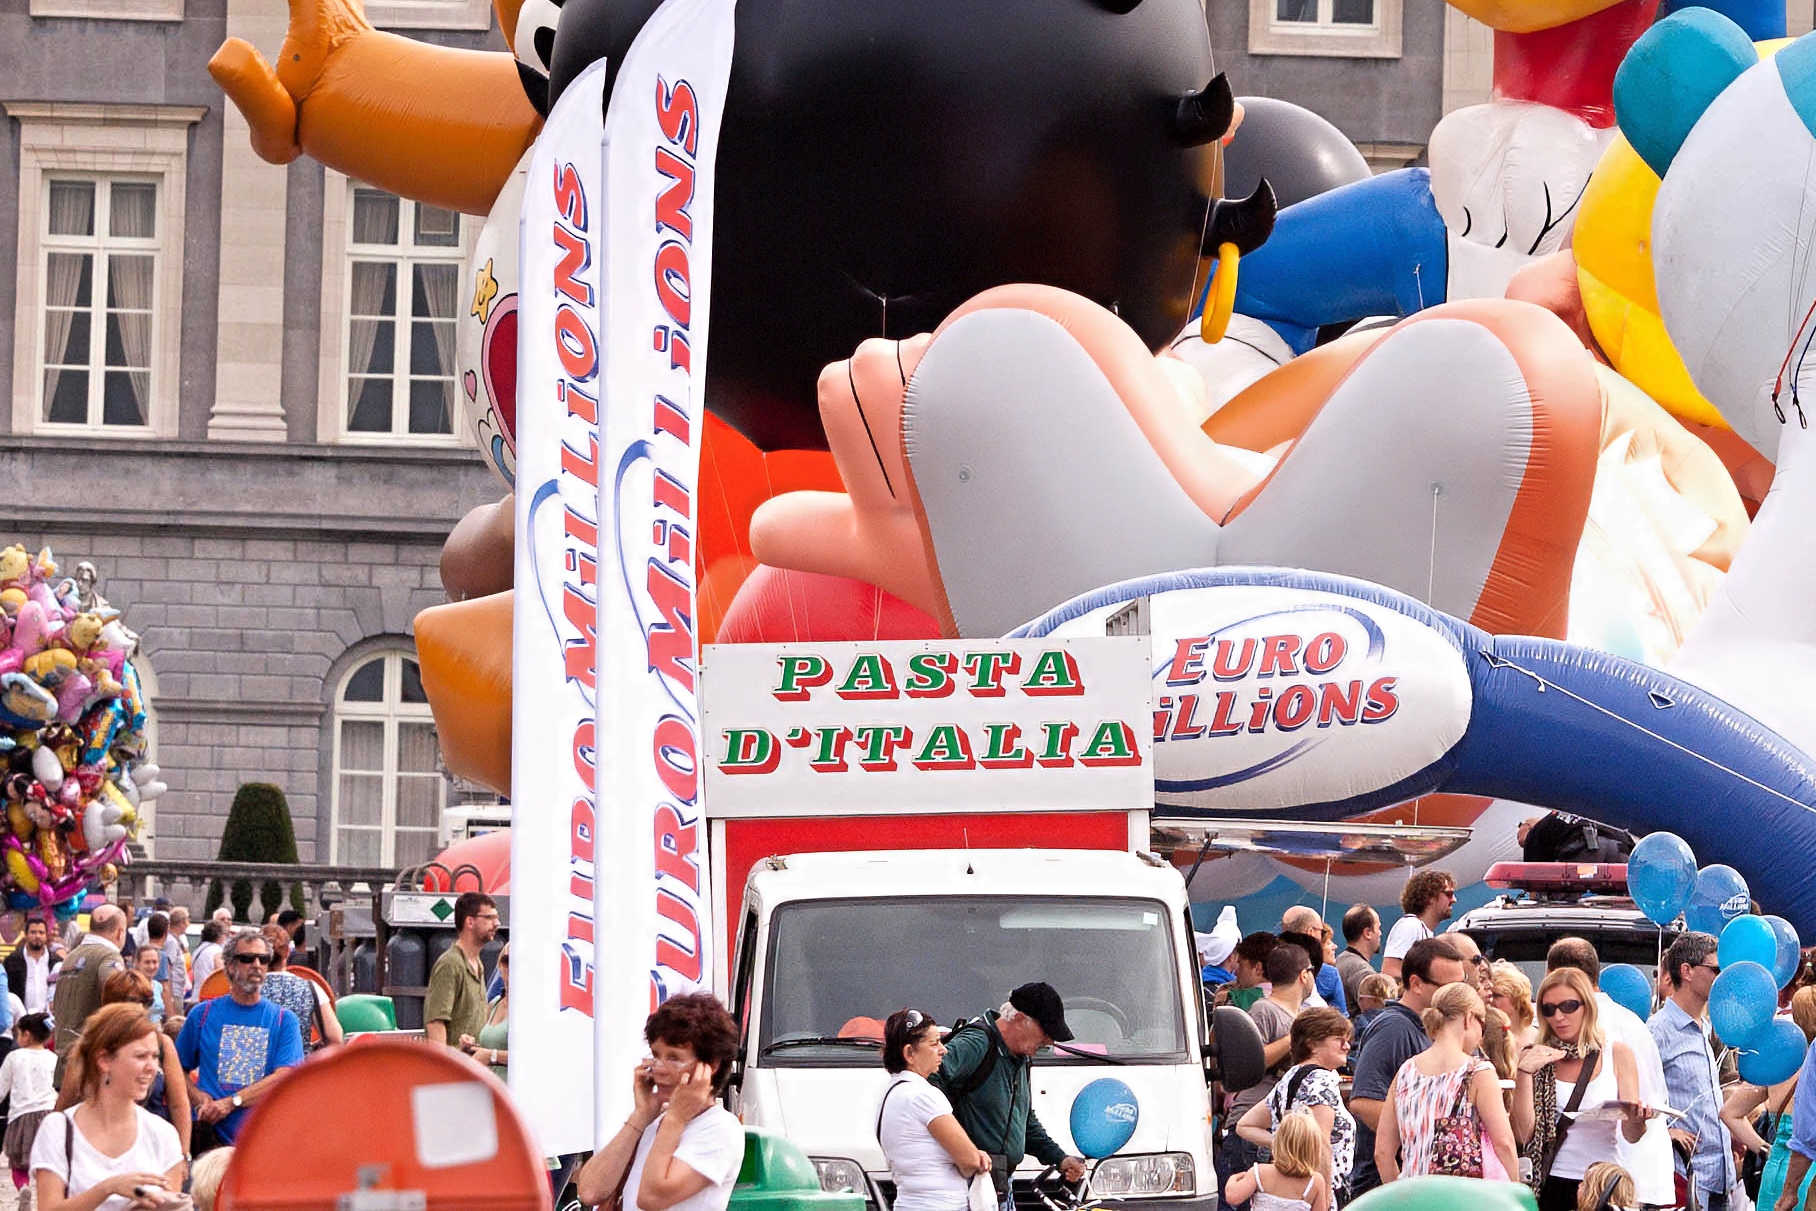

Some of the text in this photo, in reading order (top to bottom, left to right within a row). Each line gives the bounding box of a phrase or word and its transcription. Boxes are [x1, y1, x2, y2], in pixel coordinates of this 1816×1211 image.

[772, 649, 1085, 702] PASTA
[1166, 632, 1348, 687] EURO
[717, 719, 1142, 775] D'ITALIA
